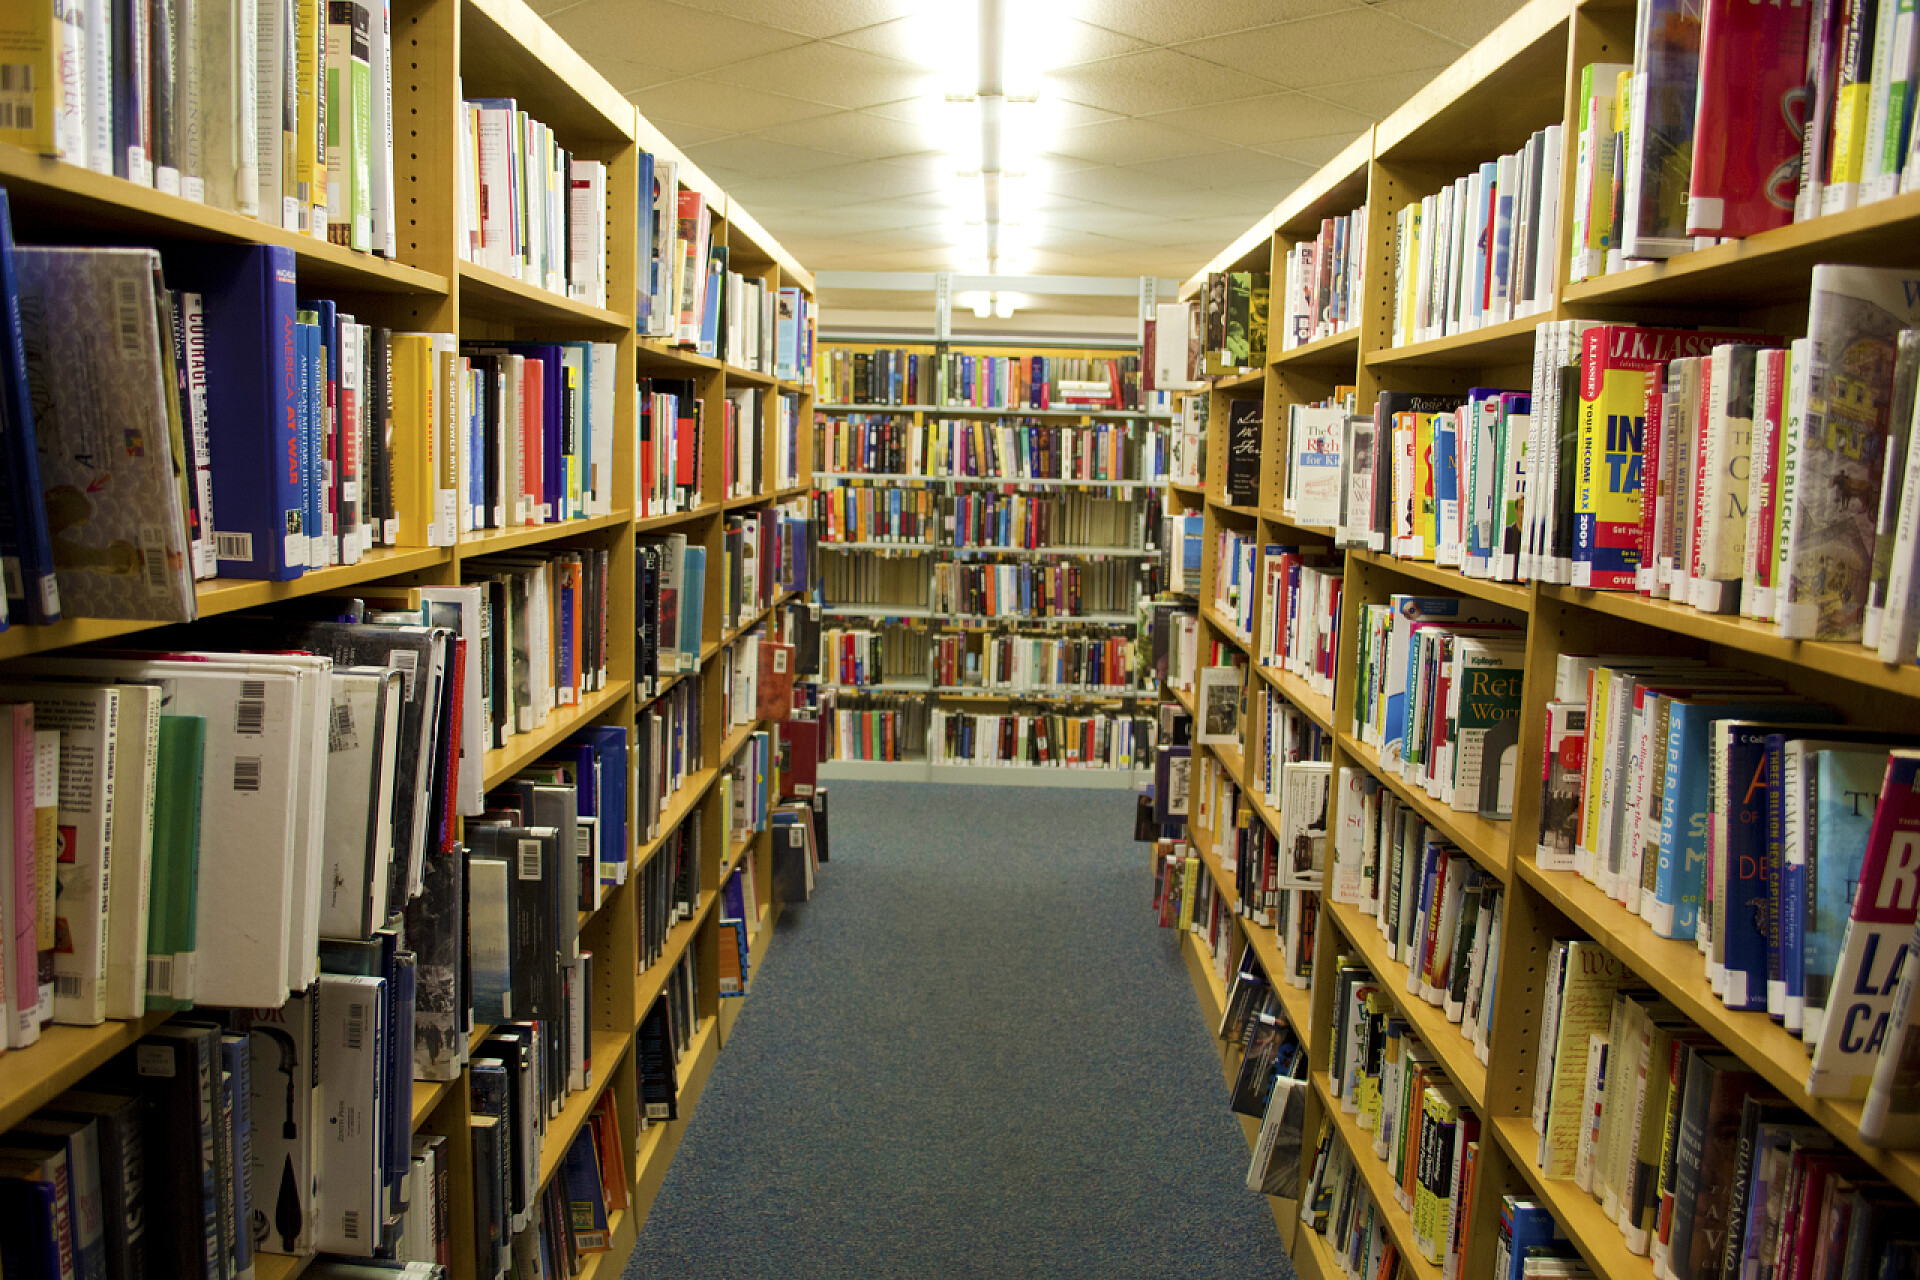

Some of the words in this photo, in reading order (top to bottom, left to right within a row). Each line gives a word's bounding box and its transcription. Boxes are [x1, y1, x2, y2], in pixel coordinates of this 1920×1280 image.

[1845, 33, 1862, 83] Energy
[318, 122, 326, 164] Court
[188, 313, 207, 390] COURAGE
[284, 314, 296, 400] AMERICA
[448, 360, 457, 378] THE
[301, 355, 309, 414] AMERICAN
[314, 356, 322, 414] AMERICAN
[1710, 382, 1720, 410] THE
[287, 405, 297, 433] AT
[448, 380, 457, 453] SUPERPOWER
[1307, 424, 1326, 437] The
[1584, 403, 1594, 434] YOUR
[1752, 368, 1766, 449] CITIZENSHIP
[1306, 436, 1339, 456] Righ
[1605, 414, 1643, 454] IN
[1705, 415, 1718, 481] CHANGE
[288, 437, 299, 485] WAR
[449, 455, 457, 484] MYTH
[1305, 454, 1322, 466] for
[1583, 437, 1593, 484] INCOME
[1603, 452, 1642, 494] TA
[1749, 451, 1762, 496] PAPERS
[302, 469, 310, 515] HISTORY
[1581, 486, 1590, 510] TAX
[1677, 467, 1687, 506] WORLD
[1696, 465, 1706, 518] CHINA
[1779, 416, 1799, 562] STARBUCKED
[1578, 513, 1590, 549] 2009
[1702, 485, 1714, 547] MAKERS
[1673, 525, 1684, 570] CURVED
[1692, 526, 1704, 579] PRICE
[1471, 656, 1504, 667] Kiplinger's
[1470, 671, 1523, 698] Ret
[107, 694, 118, 728] BADGES
[23, 740, 34, 808] UNDER
[106, 742, 117, 780] INSIGNIA
[1665, 716, 1682, 795] SUPER
[1768, 749, 1780, 787] THREE
[1601, 767, 1613, 809] Google
[1785, 751, 1798, 857] KRUGMAN
[44, 816, 53, 850] WHAT
[103, 816, 113, 843] THIRD
[1659, 796, 1675, 870] MARIO
[1739, 811, 1759, 823] OF
[1768, 790, 1780, 838] BILLION
[24, 840, 35, 905] SABERS
[44, 853, 52, 888] EVERY
[102, 846, 112, 870] REICH
[1768, 842, 1780, 869] NEW
[1807, 857, 1816, 916] POVERTY
[43, 890, 52, 941] VETERAN
[1768, 872, 1779, 948] CAPITALISTS
[240, 1046, 252, 1124] ROLLING
[240, 1131, 253, 1214] THUNDER
[1625, 1137, 1639, 1200] AMERICANS
[56, 1201, 73, 1275] POWER
